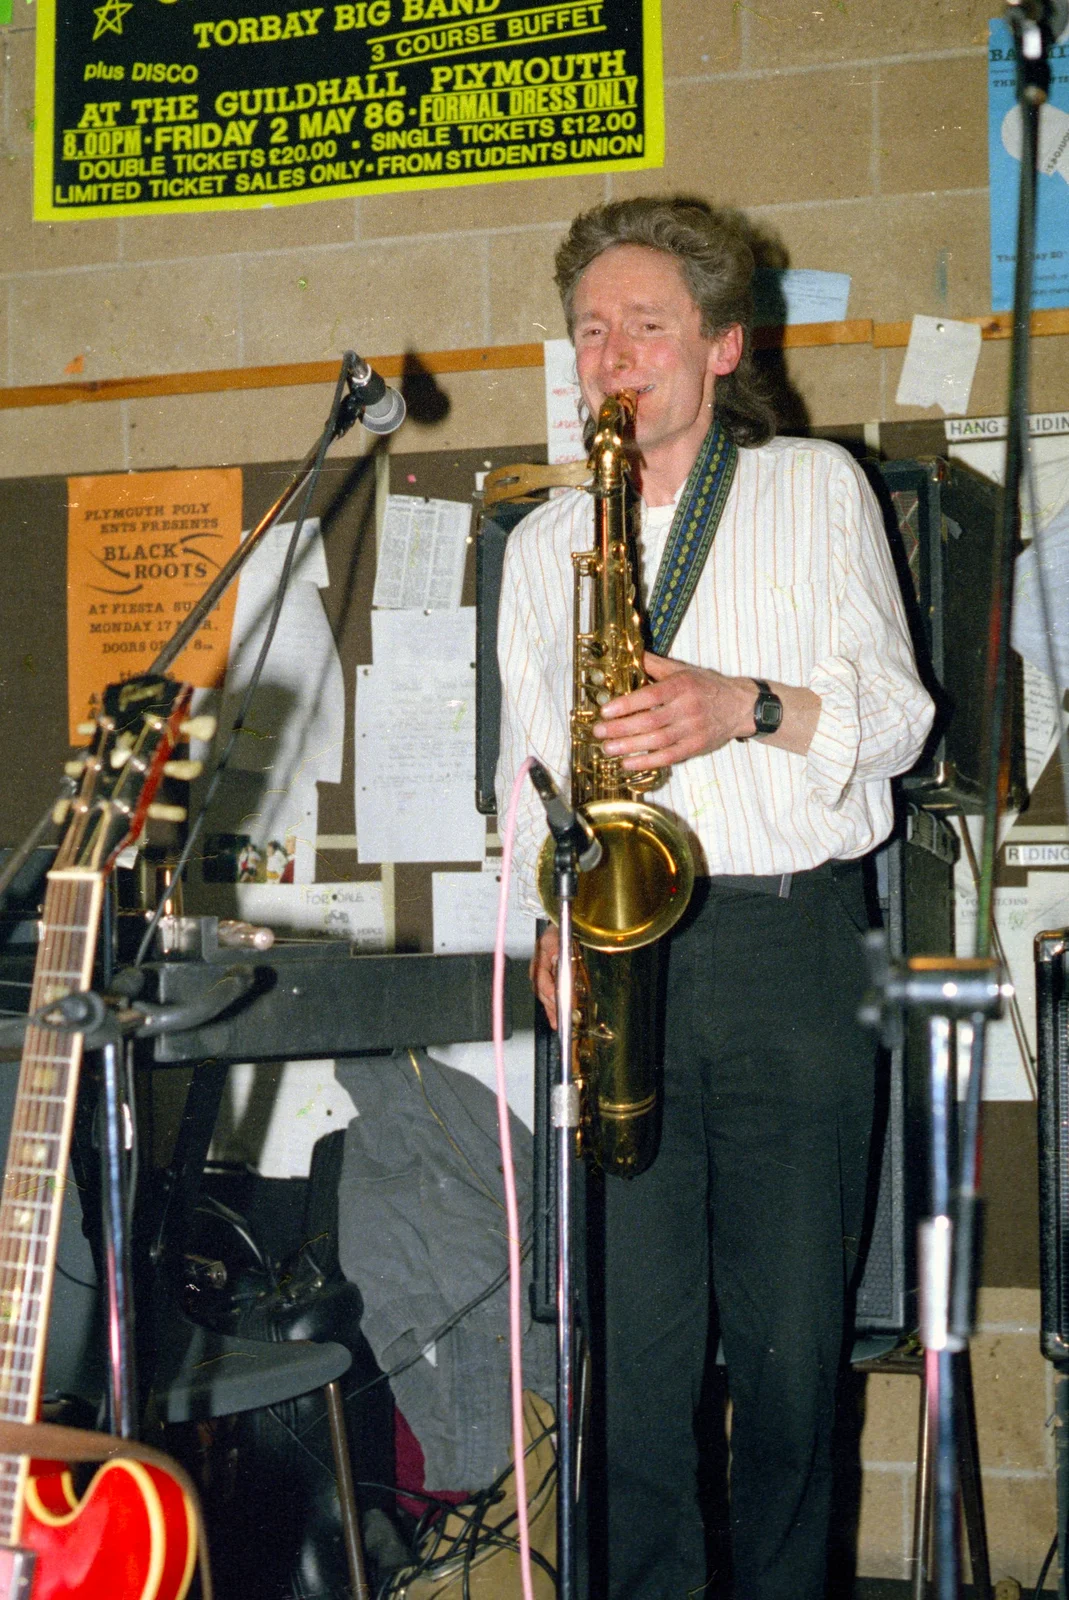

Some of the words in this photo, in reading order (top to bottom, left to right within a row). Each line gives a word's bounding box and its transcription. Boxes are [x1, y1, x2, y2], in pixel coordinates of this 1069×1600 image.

[193, 8, 323, 48] TORBAY
[334, 0, 391, 30] BIG
[402, 0, 500, 22] BAND
[371, 44, 386, 62] 3
[395, 22, 497, 58] COURSE
[508, 5, 602, 38] BUFFET
[84, 61, 125, 82] plus
[131, 62, 198, 84] DISCO
[78, 102, 121, 128] AT
[131, 95, 199, 125] THE
[215, 71, 406, 117] GUILDHALL
[430, 49, 627, 93] PLYMOUTH
[63, 129, 142, 157] 8.00PM
[154, 119, 258, 152] FRIDAY
[269, 117, 289, 143] 2
[300, 106, 357, 140] MAY
[364, 101, 405, 129] 86
[420, 93, 504, 124] FORMAL
[509, 85, 577, 116] DRESS
[583, 77, 639, 109] ONLY
[79, 155, 167, 181] DOUBLE
[173, 148, 266, 174] TICKETS
[269, 140, 338, 166] £20.00
[371, 126, 451, 152] SINGLE
[457, 117, 555, 145] TICKETS
[561, 110, 636, 136] £12.00
[54, 180, 142, 204] LIMITED
[148, 175, 228, 198] TICKET
[235, 167, 306, 193] SALES
[310, 159, 366, 184] ONLY
[376, 151, 443, 176] FROM
[445, 142, 569, 170] STUDENTS
[570, 134, 644, 160] UNION
[84, 504, 165, 521] PLYMOUTH
[172, 503, 210, 517] POLY
[100, 520, 137, 534] ENTS
[141, 518, 219, 533] PRESENTS
[103, 542, 179, 561] BLACK
[134, 562, 208, 580] ROOTS
[88, 602, 109, 616] AT
[111, 600, 165, 615] FIESTA
[90, 619, 152, 634] MONDAY
[156, 620, 172, 632] 17
[102, 641, 146, 654] DOORS
